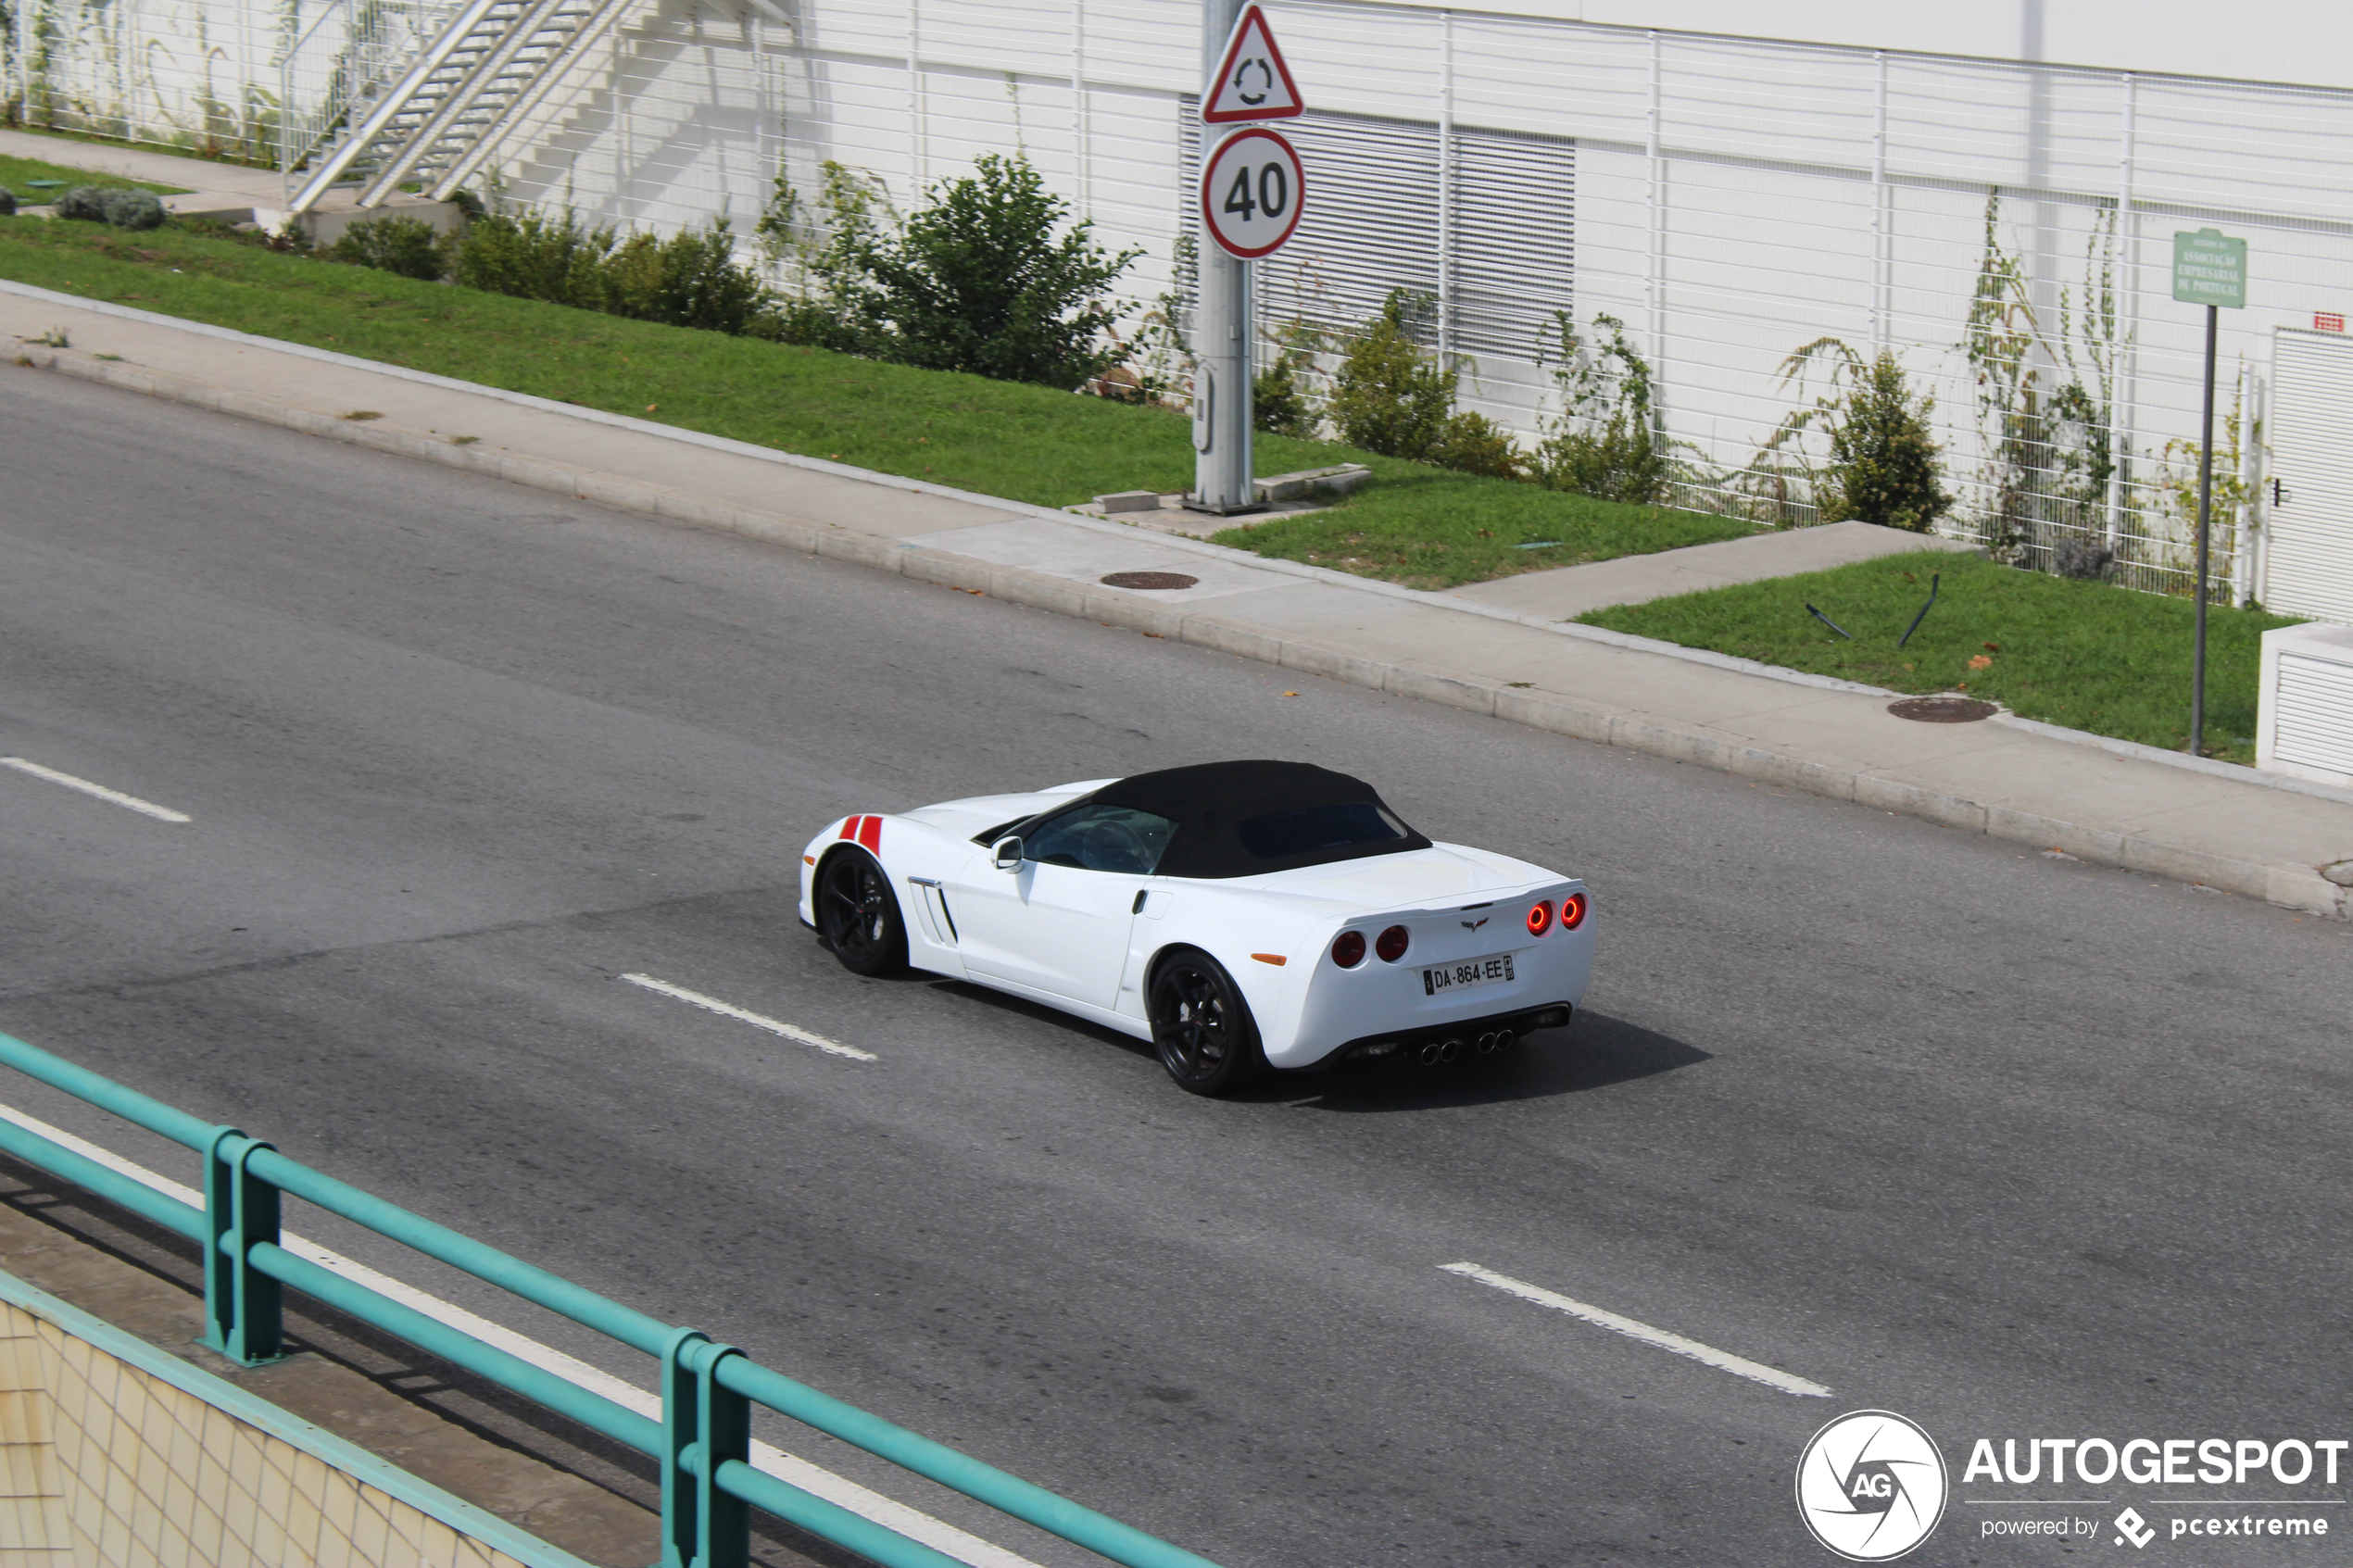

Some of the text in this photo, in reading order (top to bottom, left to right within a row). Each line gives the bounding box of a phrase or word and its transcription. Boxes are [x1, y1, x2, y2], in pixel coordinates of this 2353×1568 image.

[1224, 161, 1287, 222] 40
[2183, 251, 2237, 268] ASSOCIAÇÃO
[2178, 264, 2240, 282] EMPRESARIAL
[2178, 278, 2239, 296] DE PORTUGAL
[1434, 960, 1503, 988] DA-864-EE
